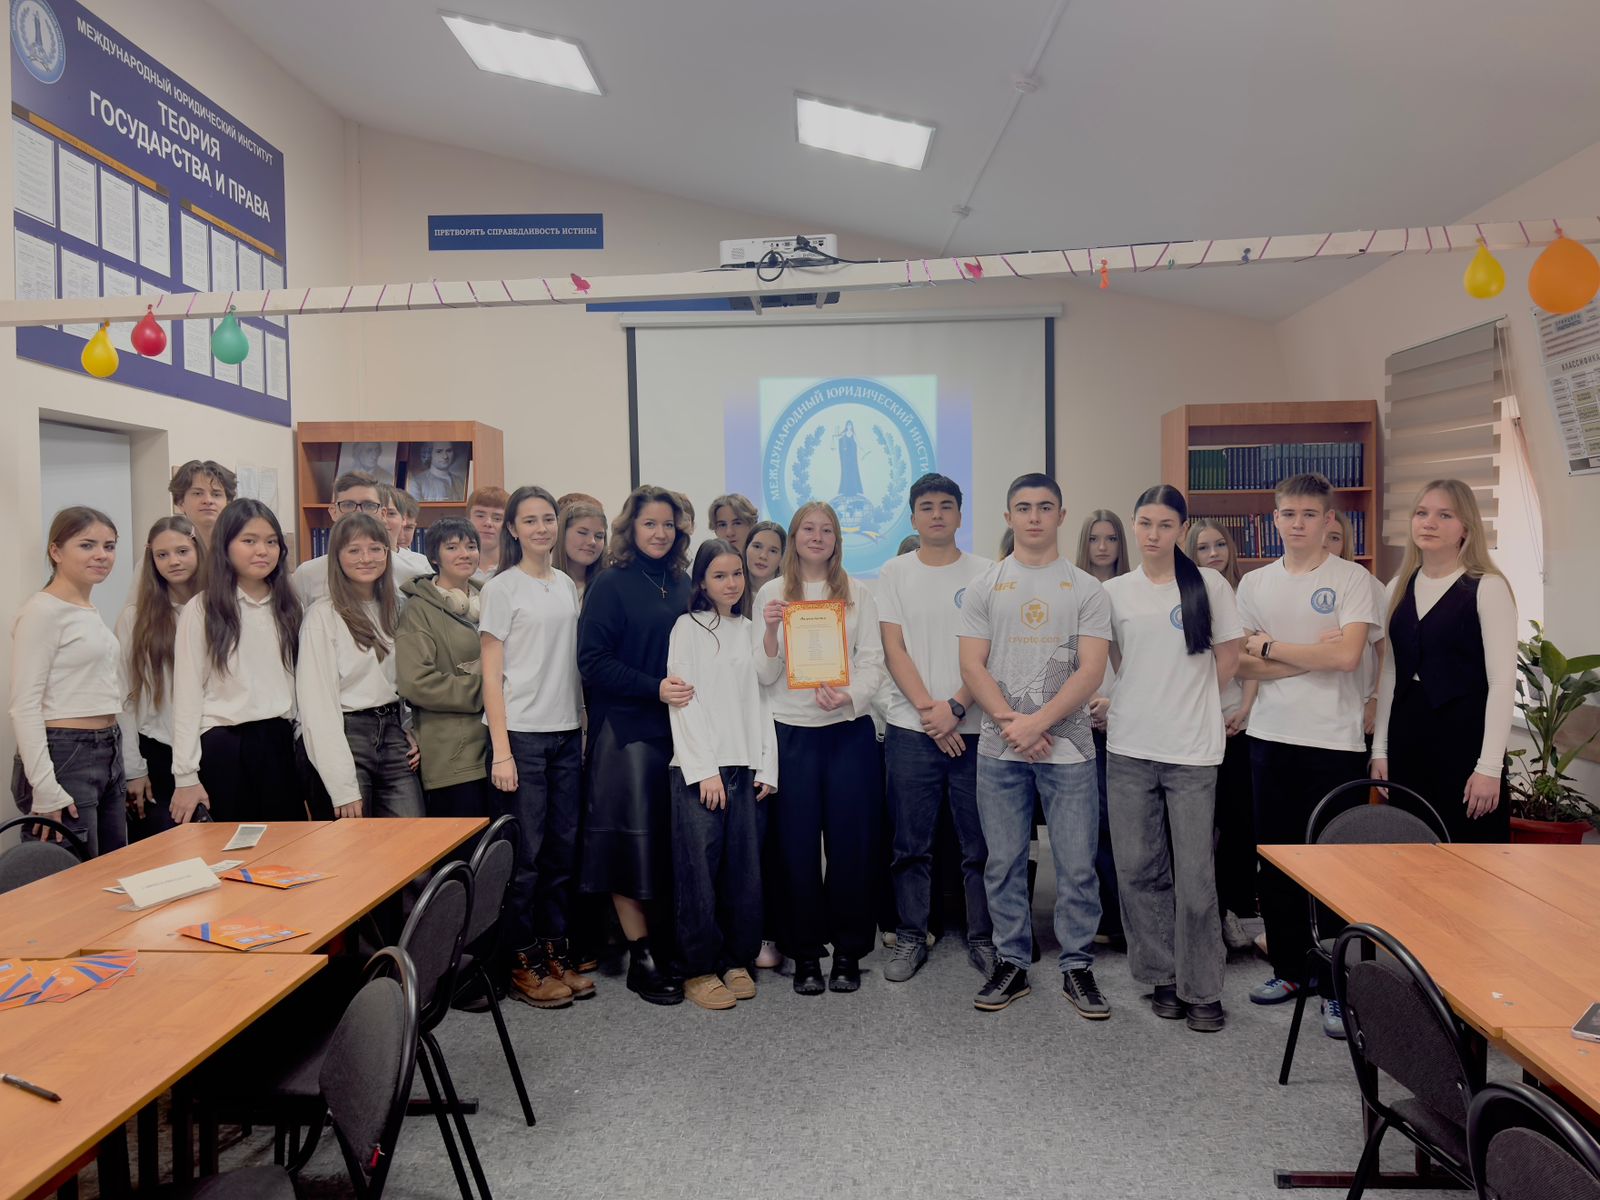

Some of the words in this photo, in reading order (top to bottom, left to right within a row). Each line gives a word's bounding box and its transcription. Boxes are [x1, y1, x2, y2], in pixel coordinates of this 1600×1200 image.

[76, 17, 172, 95] МЕЖДУНАРОДНЫЙ
[173, 86, 237, 138] ЮРИДИЧЕСКИЙ
[237, 133, 274, 165] ИНСТИТУТ
[157, 101, 221, 162] ТЕОРИЯ
[90, 90, 212, 188] ГОСУДАРСТВА
[215, 173, 226, 192] И
[228, 180, 271, 222] ПРАВА
[486, 227, 561, 236] СПРАВЕДЛИВОСТЬ
[562, 227, 598, 235] ИСТИНЫ
[768, 391, 825, 501] МЕЖДУНАРОДНЫЙ
[826, 385, 914, 423] ЮРИДИЧЕСКИЙ
[910, 426, 929, 472] ИНСТИ
[994, 581, 1017, 592] UFC
